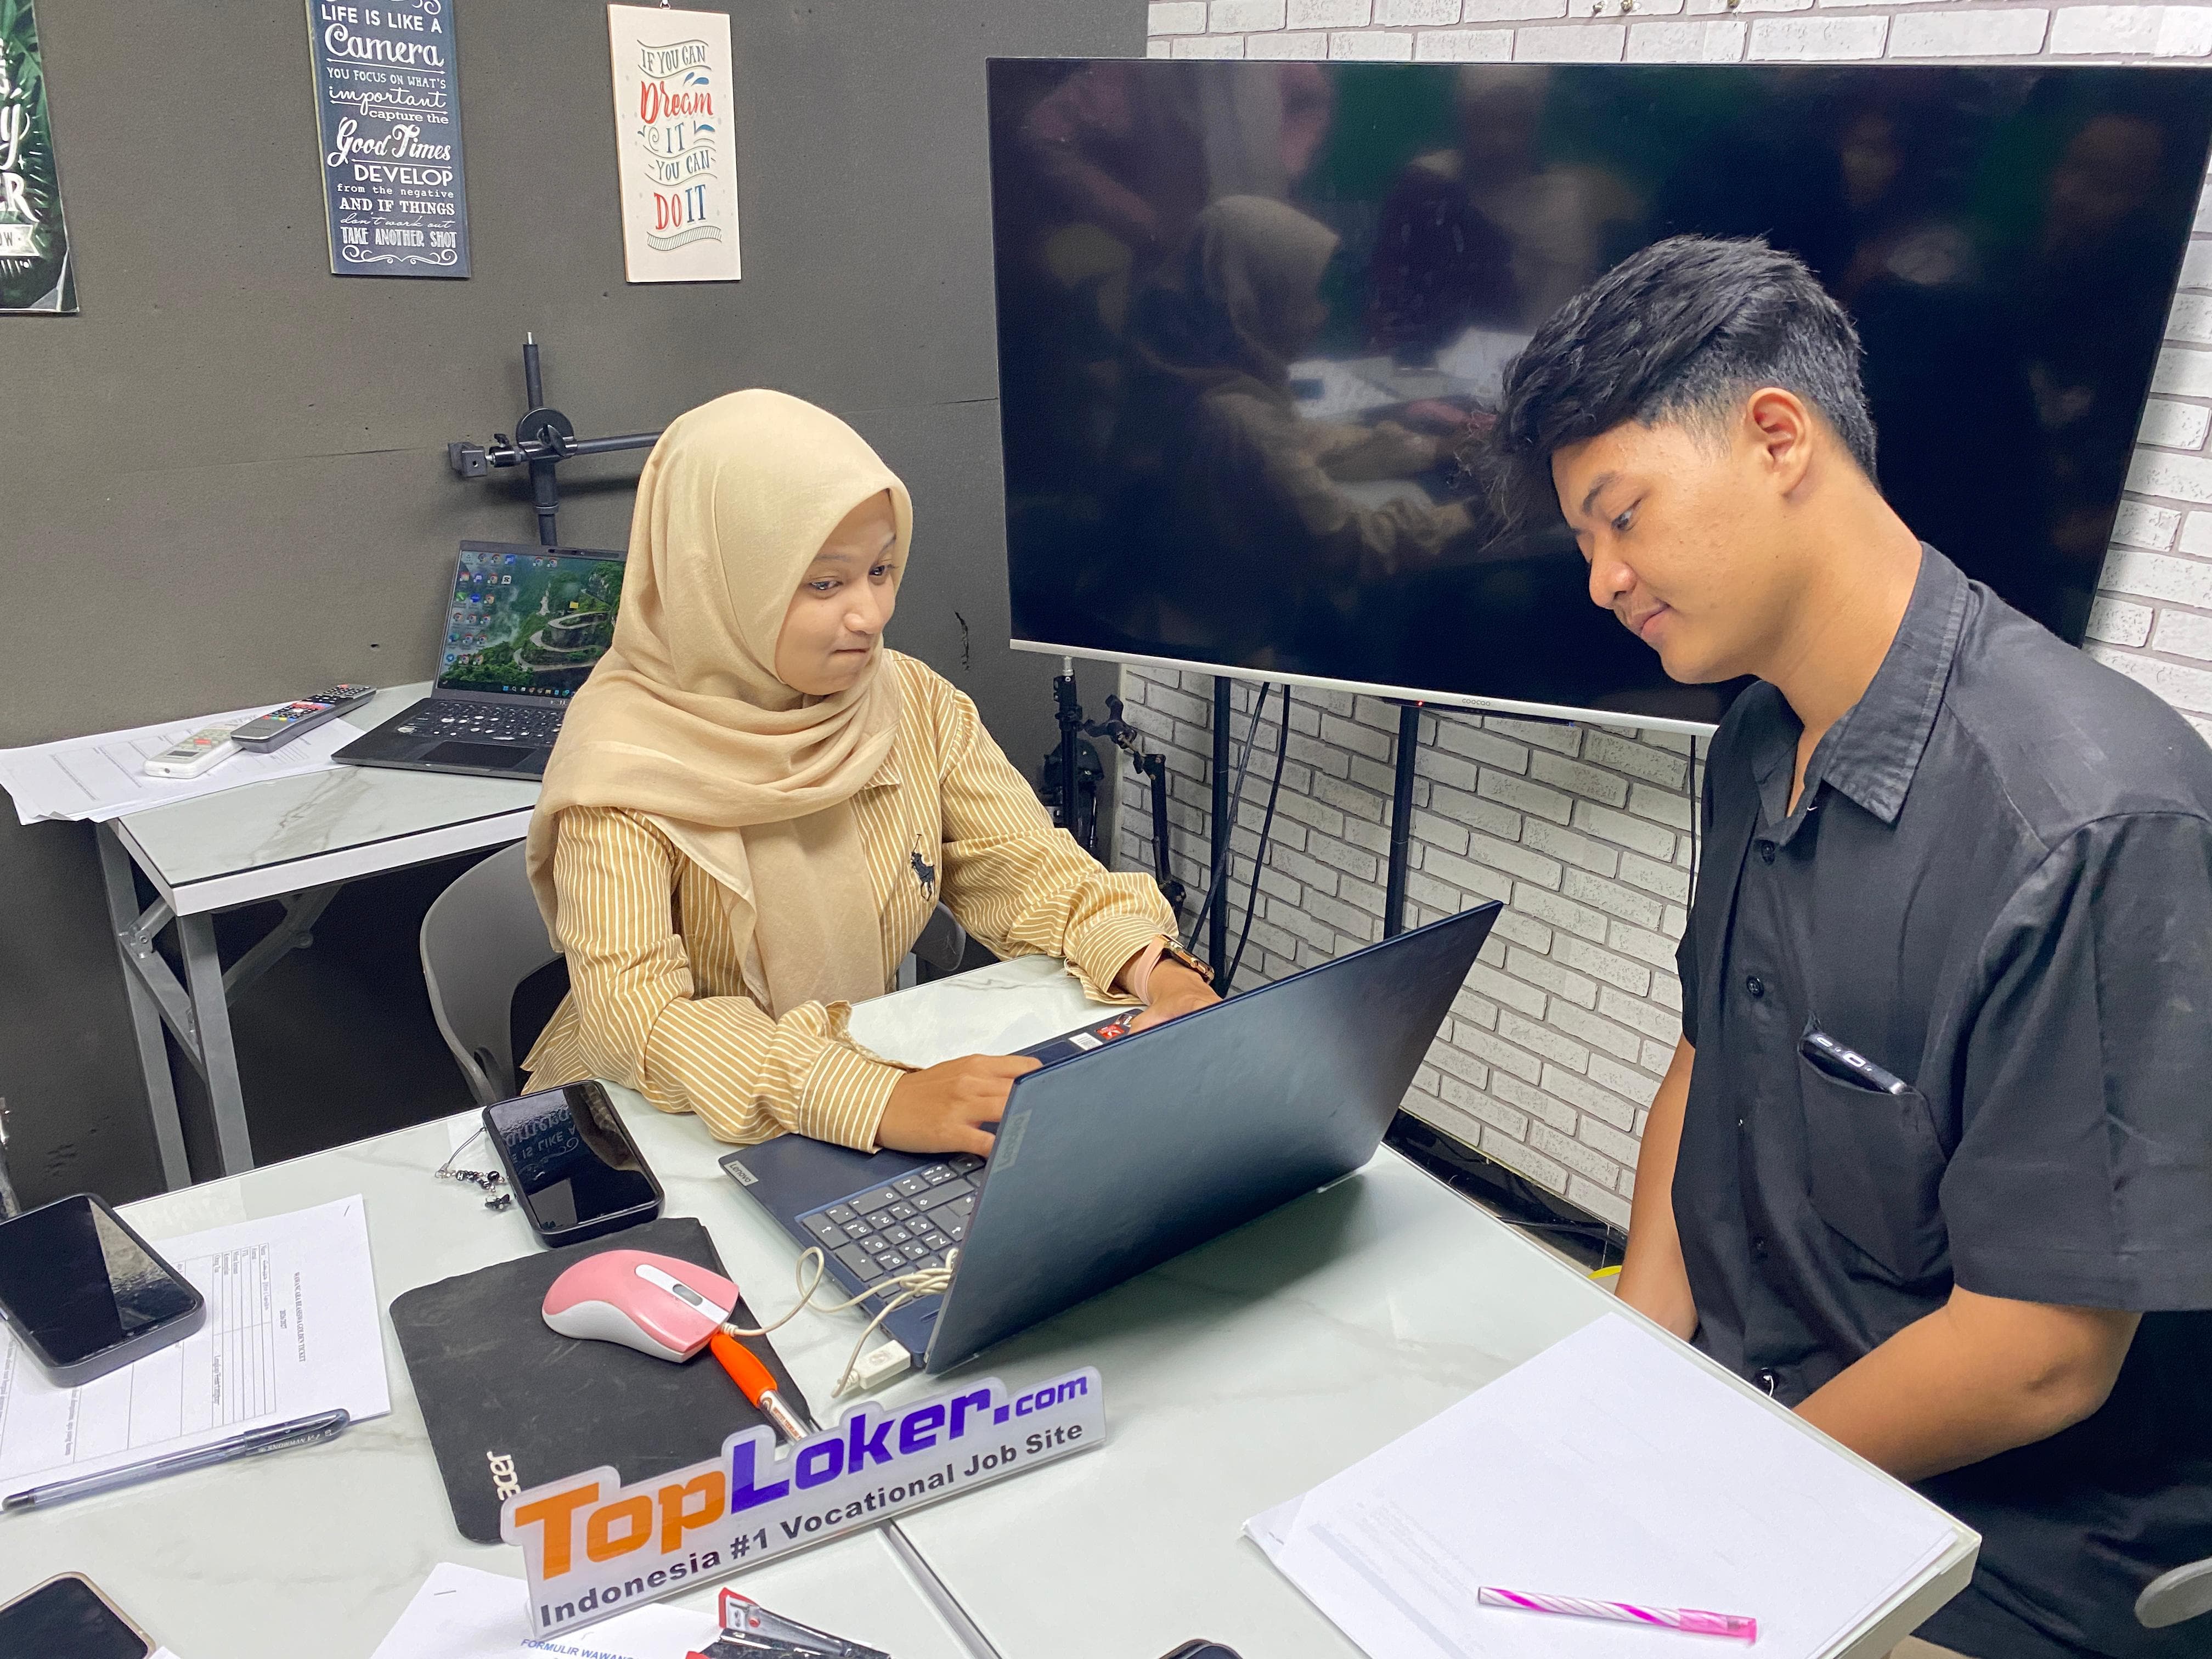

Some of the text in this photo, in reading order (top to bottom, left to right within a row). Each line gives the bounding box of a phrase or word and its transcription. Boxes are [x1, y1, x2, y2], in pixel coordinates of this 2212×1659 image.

[321, 4, 442, 33] LIFE IS LIKE A
[325, 23, 444, 67] Camera
[641, 44, 706, 74] IF YOU CAN
[326, 67, 446, 89] YOU FOCUS ON WHAT'S
[329, 86, 447, 116] important
[640, 80, 714, 125] Dream
[369, 110, 449, 124] capture the
[327, 116, 451, 167] Good Times
[666, 122, 685, 154] IT
[354, 164, 453, 187] DEVELOP
[656, 150, 710, 181] YOU CAN
[337, 183, 454, 198] from the negative
[339, 197, 455, 216] AND IF THINGS
[340, 212, 386, 225] don't
[385, 216, 424, 227] work
[653, 184, 707, 230] DO IT
[340, 227, 458, 249] TAKE ANOTHER SHOT
[730, 1163, 751, 1182] Lenovo
[267, 1438, 305, 1451] SNOWMAN
[487, 1451, 521, 1500] acer
[515, 1376, 1088, 1581] TopLoker.com
[540, 1425, 1082, 1627] Indonesia #1 Vocational Job Site
[521, 1639, 579, 1656] FORMULIR
